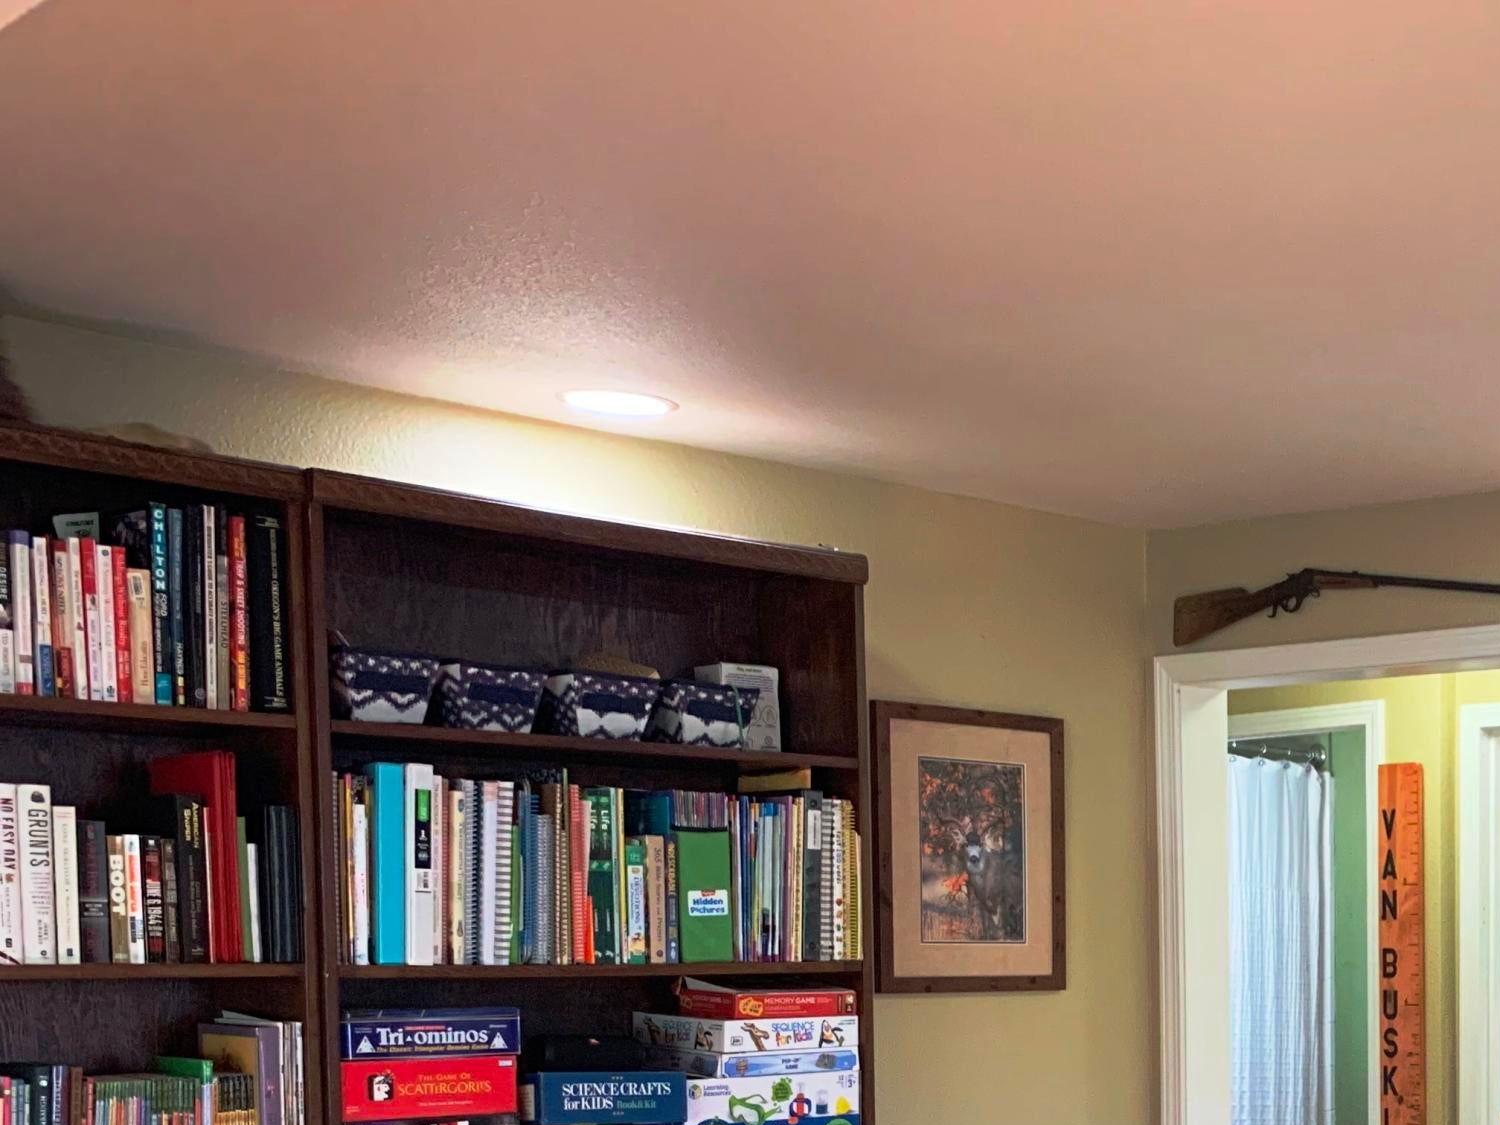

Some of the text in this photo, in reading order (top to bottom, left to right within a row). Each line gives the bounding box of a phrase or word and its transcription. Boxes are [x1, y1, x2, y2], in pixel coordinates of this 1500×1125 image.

[154, 509, 167, 591] CHILTON
[0, 567, 8, 600] DESIRE
[220, 601, 229, 649] STEELHEAD
[273, 621, 281, 635] BIG
[273, 637, 282, 661] GAME
[191, 802, 200, 849] AMERICAN
[601, 810, 610, 830] Life
[1, 798, 16, 870] NO EASY DAY
[28, 808, 50, 867] GRUNTS
[1381, 808, 1398, 922] VAN
[109, 854, 126, 916] BOOT
[146, 879, 163, 925] JUNE 1944
[690, 905, 725, 914] Pictures
[692, 897, 723, 906] Hidden
[795, 996, 816, 1004] GAME
[771, 1020, 815, 1033] SEQUENCE
[776, 1033, 791, 1047] for
[399, 1080, 492, 1096] SCATTERGORIES
[562, 1081, 672, 1097] SCIENCE CRAFTS
[563, 1097, 580, 1111] for
[581, 1096, 614, 1110] KIDS
